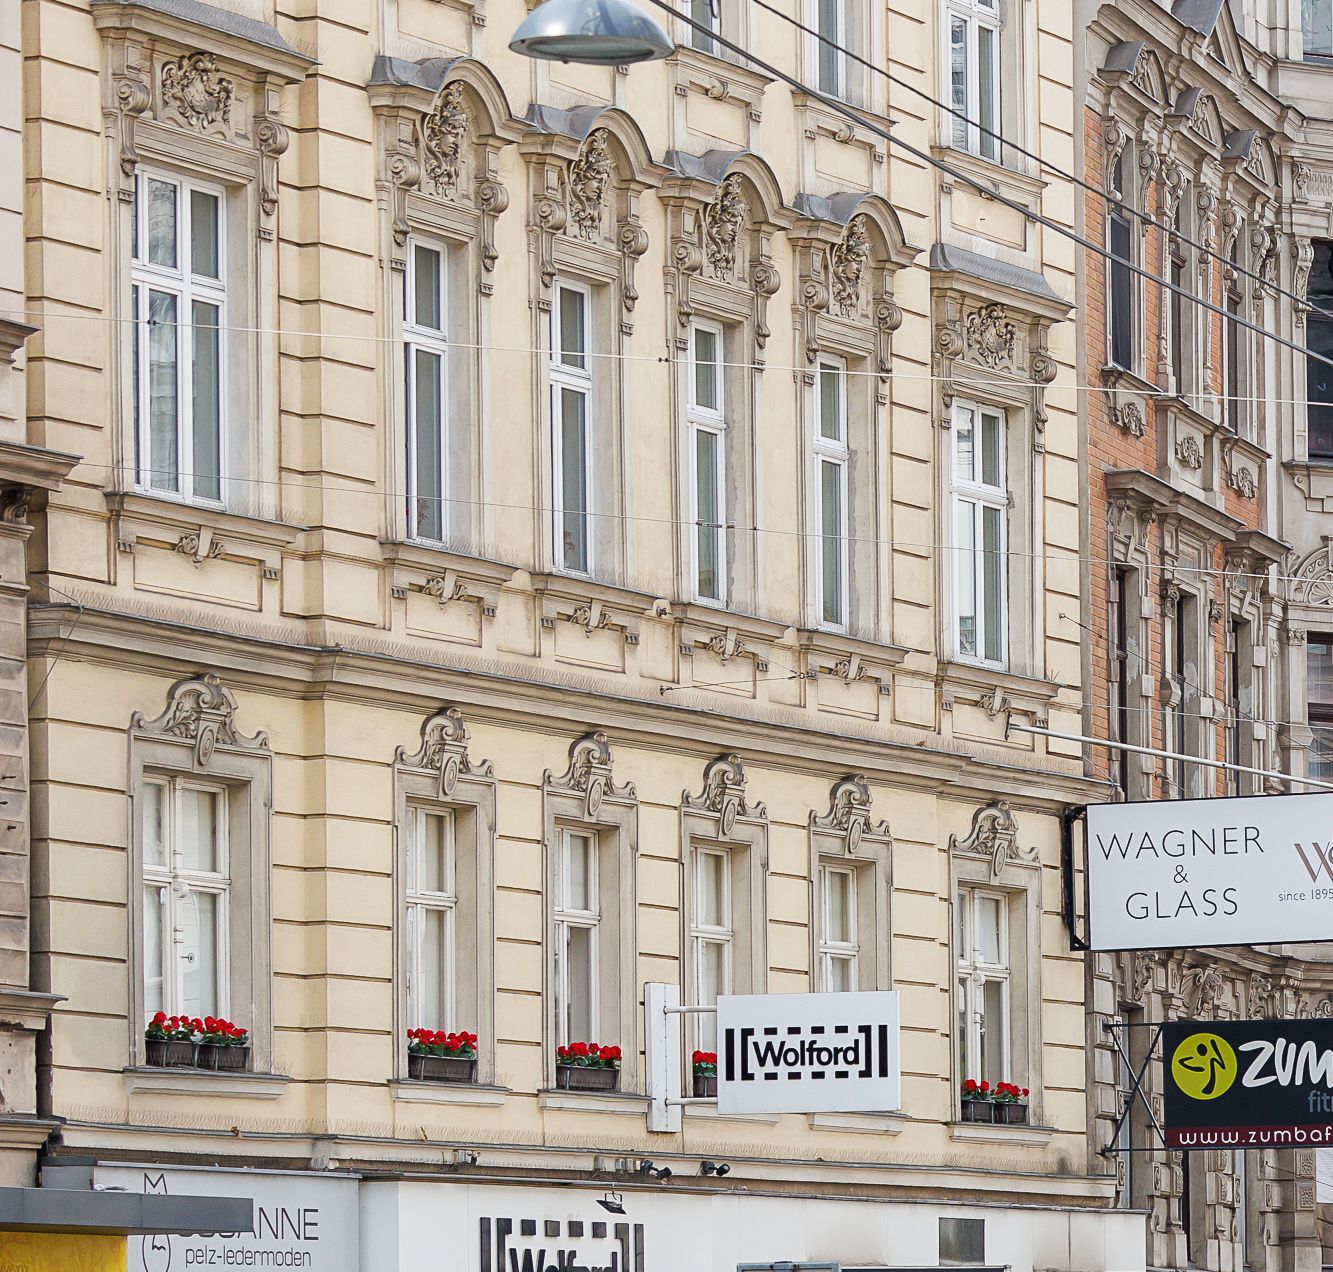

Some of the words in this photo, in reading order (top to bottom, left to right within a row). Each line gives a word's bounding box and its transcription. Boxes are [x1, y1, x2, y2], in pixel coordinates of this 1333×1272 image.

[1096, 826, 1264, 860] WAGNER
[1173, 864, 1188, 884] &
[1125, 888, 1238, 919] GLASS
[1278, 892, 1306, 902] since
[752, 1039, 860, 1068] Wolford
[185, 1245, 312, 1268] pelz-ledermoden
